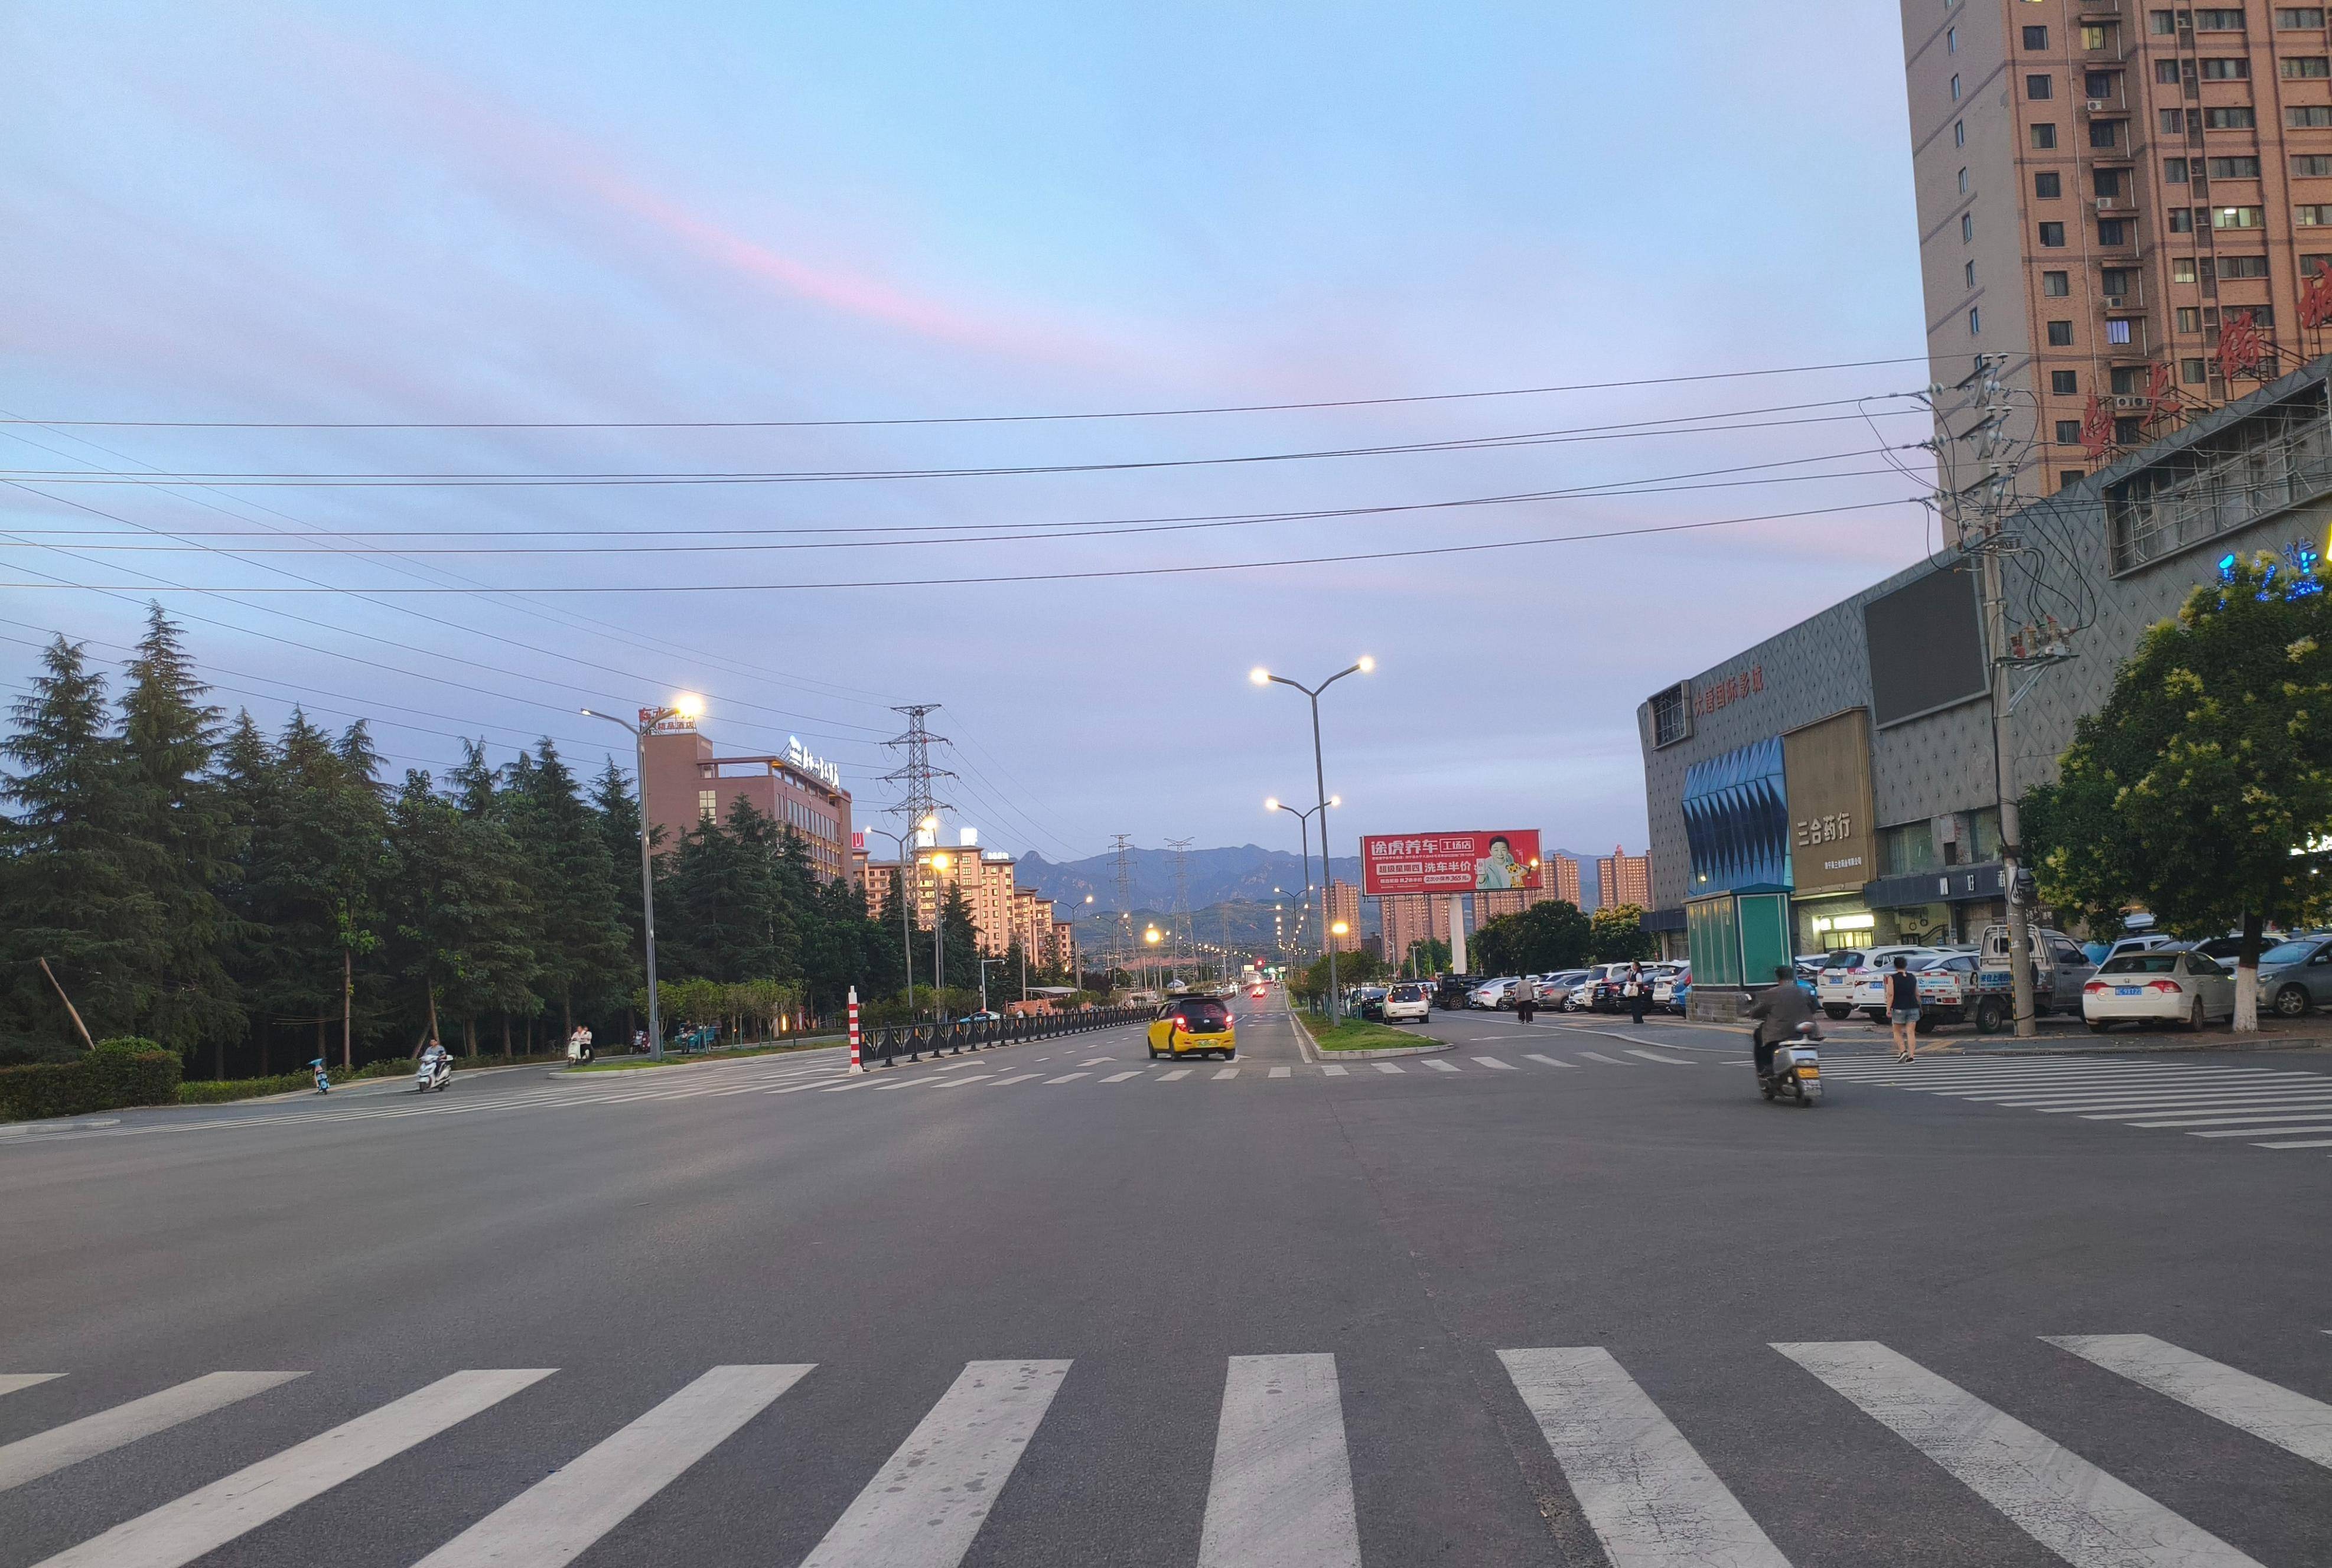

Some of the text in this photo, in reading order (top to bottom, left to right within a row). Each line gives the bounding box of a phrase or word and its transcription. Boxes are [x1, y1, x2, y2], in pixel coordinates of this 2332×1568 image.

[1695, 664, 1763, 718] 大唐国际影城
[658, 721, 693, 730] 精品酒店
[1797, 812, 1850, 846] 三合药行
[1371, 839, 1438, 855] 途虎养车
[1443, 841, 1471, 850] 工场店
[1379, 864, 1420, 873] 超级星期四
[1424, 861, 1471, 873] 洗车半价
